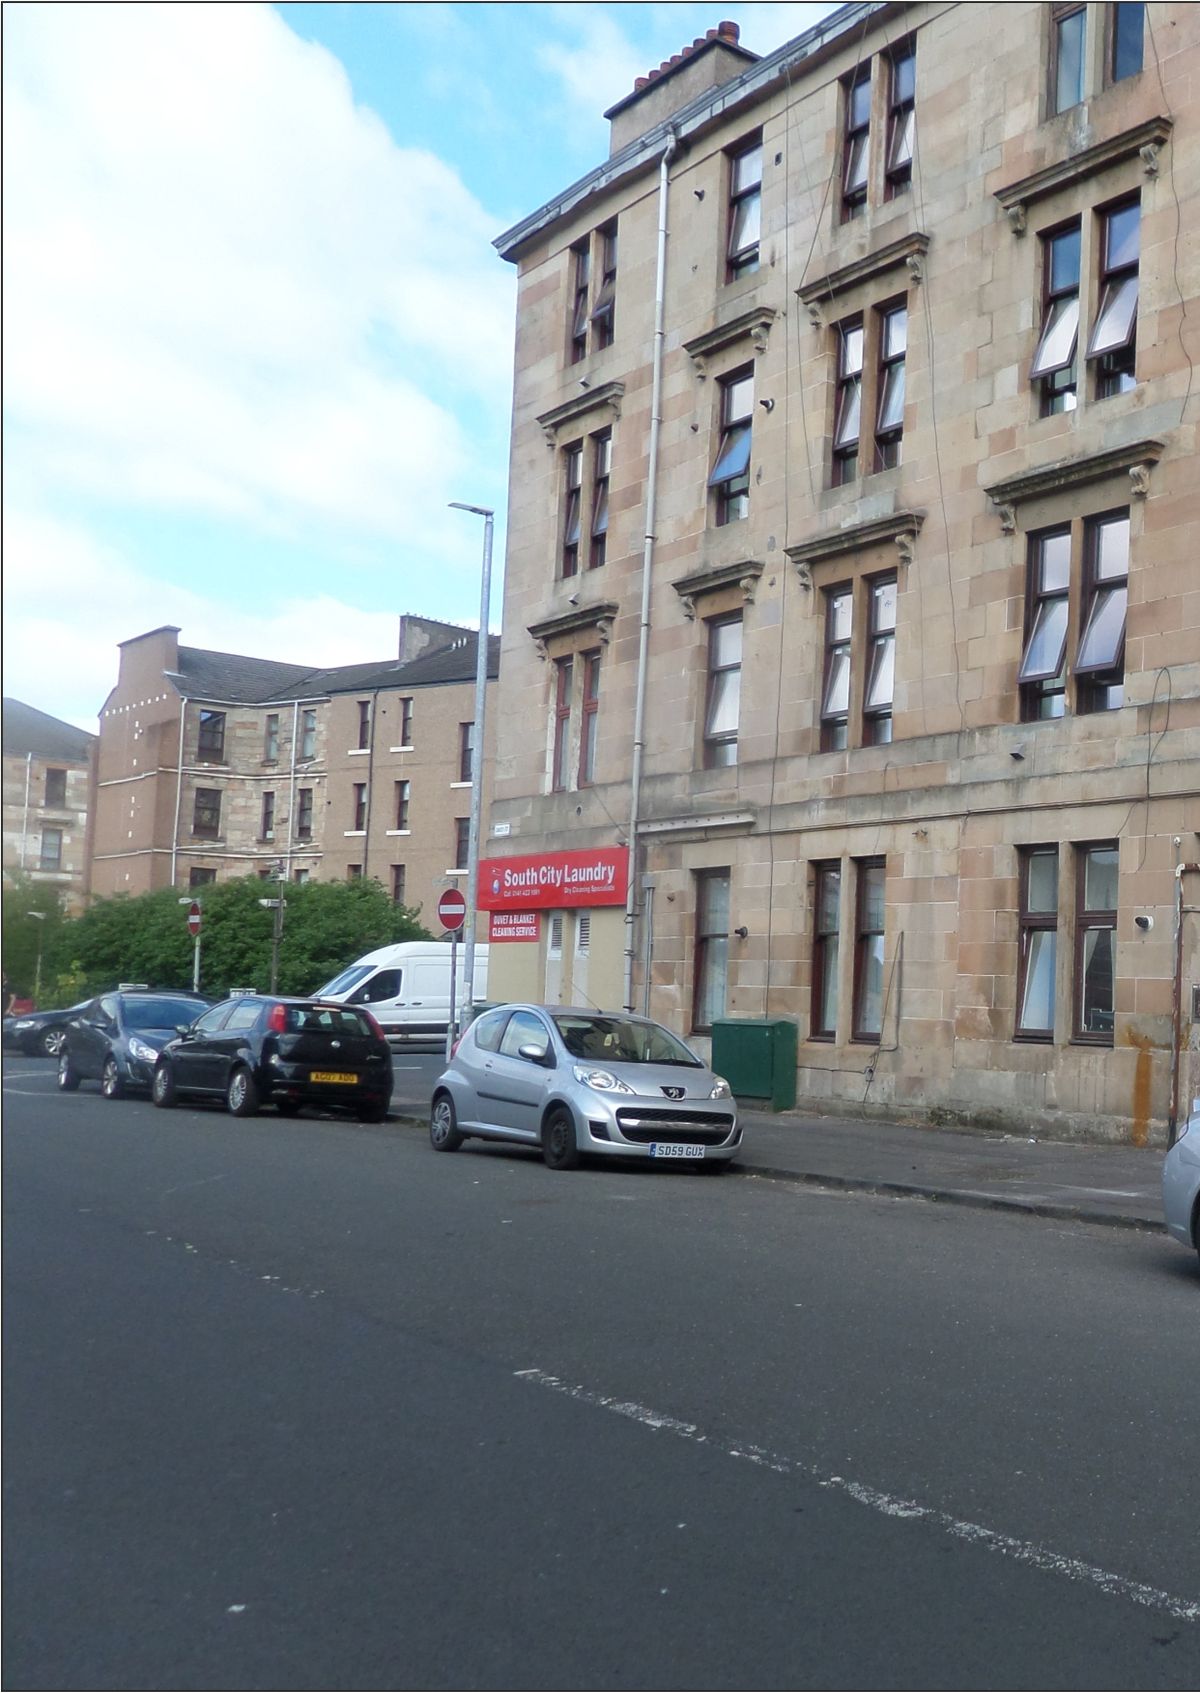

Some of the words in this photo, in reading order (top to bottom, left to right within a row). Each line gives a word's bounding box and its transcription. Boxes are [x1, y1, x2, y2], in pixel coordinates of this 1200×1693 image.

[504, 867, 538, 887] South
[539, 865, 562, 887] City
[564, 862, 615, 884] Laundry
[493, 915, 509, 924] DUVET
[509, 915, 513, 924] &
[513, 914, 536, 924] BLANKET
[492, 927, 516, 937] CLEANING
[516, 926, 536, 936] SERVICE
[658, 1145, 684, 1156] SD59
[685, 1146, 704, 1157] GUX
